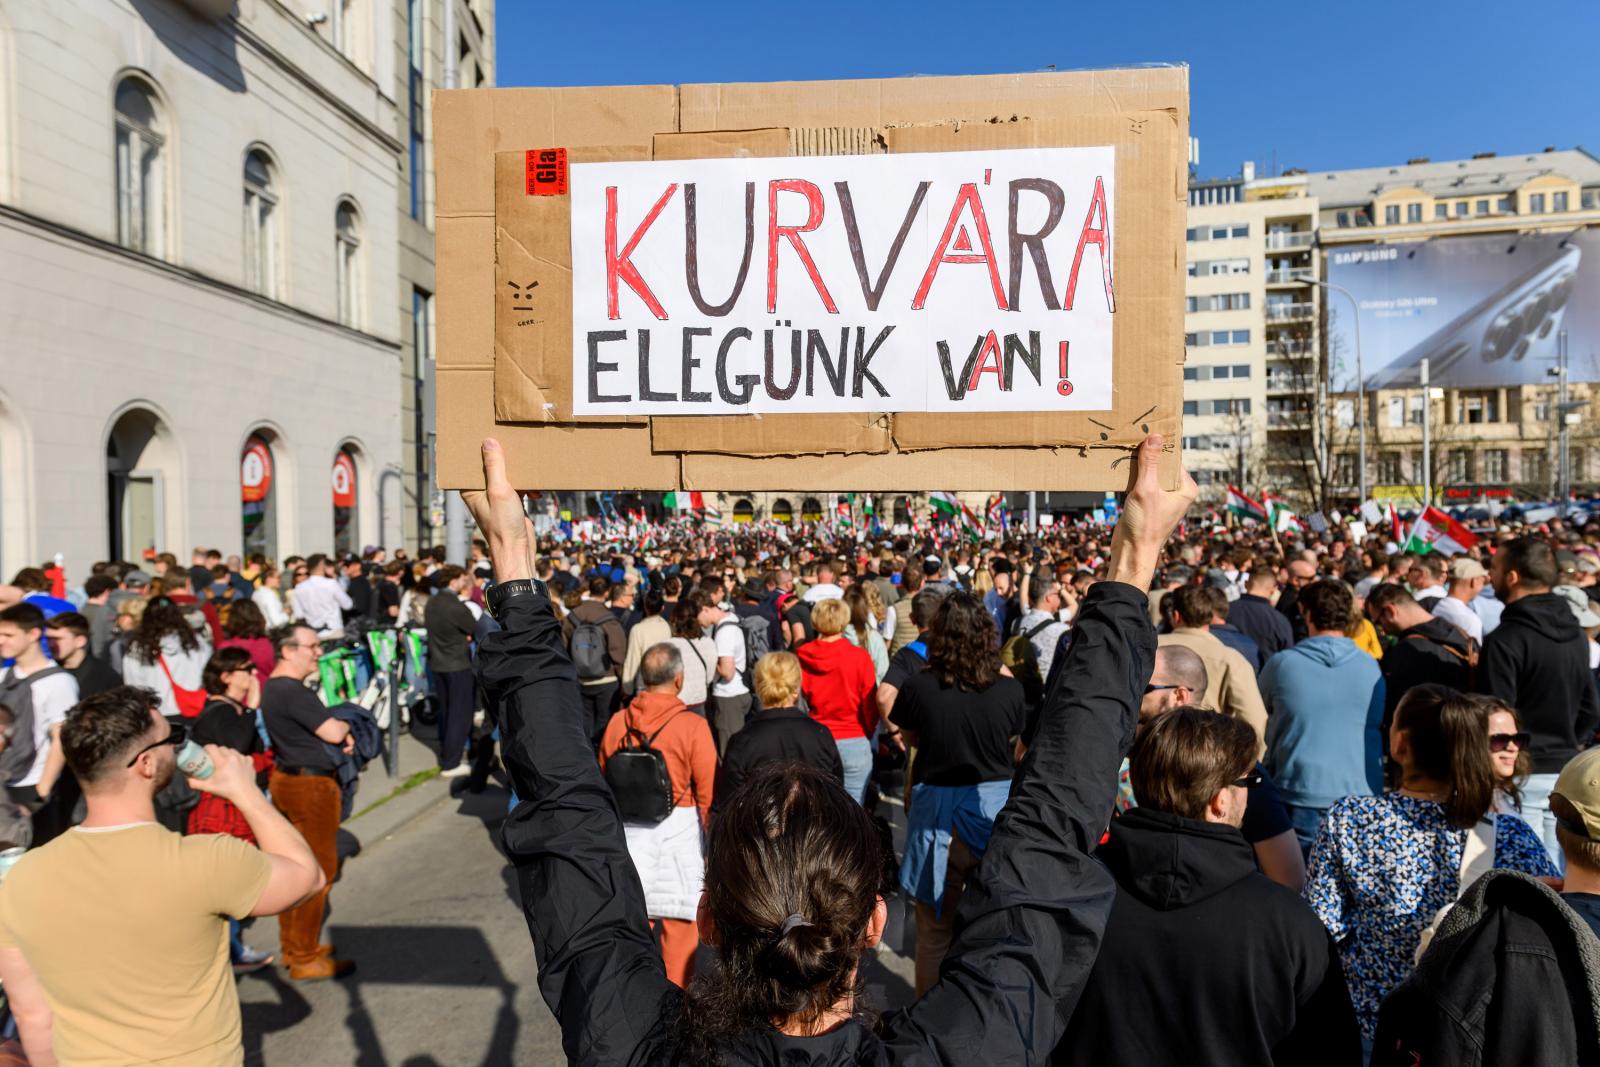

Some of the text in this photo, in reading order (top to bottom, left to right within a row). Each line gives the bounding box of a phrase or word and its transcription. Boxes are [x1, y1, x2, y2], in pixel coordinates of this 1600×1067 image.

[536, 148, 557, 183] Gla
[605, 169, 1116, 320] KURVÁRA
[1334, 248, 1398, 265] SAMSUNG
[587, 320, 897, 405] ELEGÜNK
